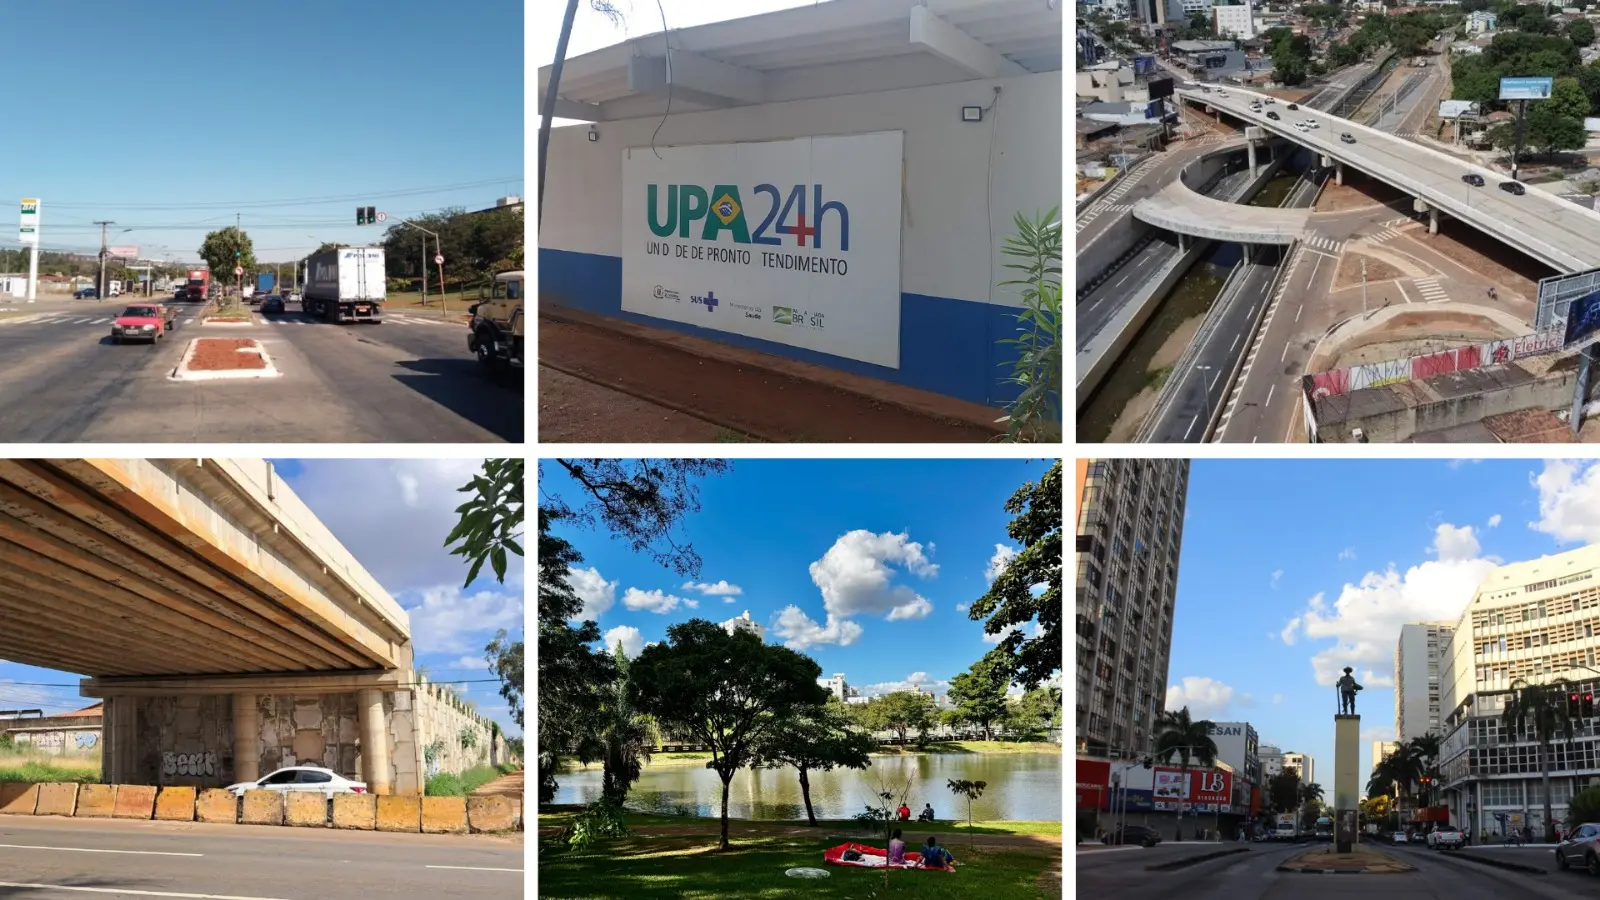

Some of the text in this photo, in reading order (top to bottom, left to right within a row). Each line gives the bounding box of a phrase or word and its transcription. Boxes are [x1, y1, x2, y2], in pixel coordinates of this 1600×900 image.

[647, 183, 849, 252] UPA 24h
[691, 245, 704, 260] DE
[707, 247, 751, 265] PRONTO
[761, 252, 848, 276] TENDIMENTO
[690, 295, 703, 304] SUS
[792, 313, 825, 328] BRSIL
[1200, 772, 1225, 792] LB
